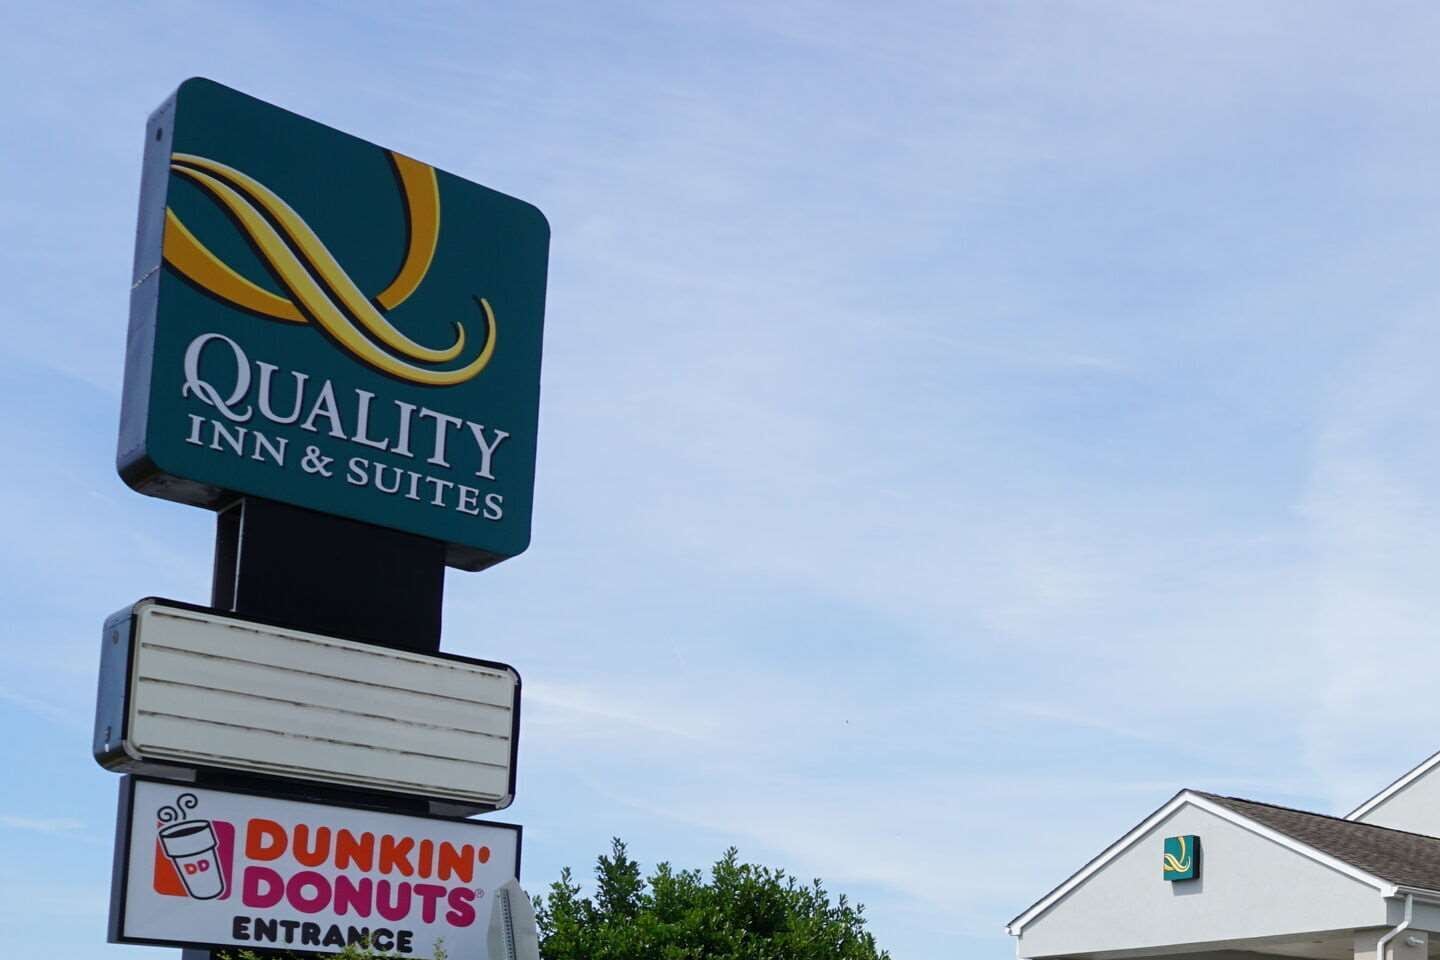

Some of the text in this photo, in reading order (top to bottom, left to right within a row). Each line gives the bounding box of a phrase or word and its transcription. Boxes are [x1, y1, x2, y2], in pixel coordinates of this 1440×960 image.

[182, 333, 510, 480] QUALITY
[186, 414, 504, 520] INN & SUITES
[183, 859, 210, 875] DD
[245, 818, 490, 883] DUNKIN'
[242, 866, 476, 927] DONUTS
[232, 916, 413, 953] ENTRANCE
